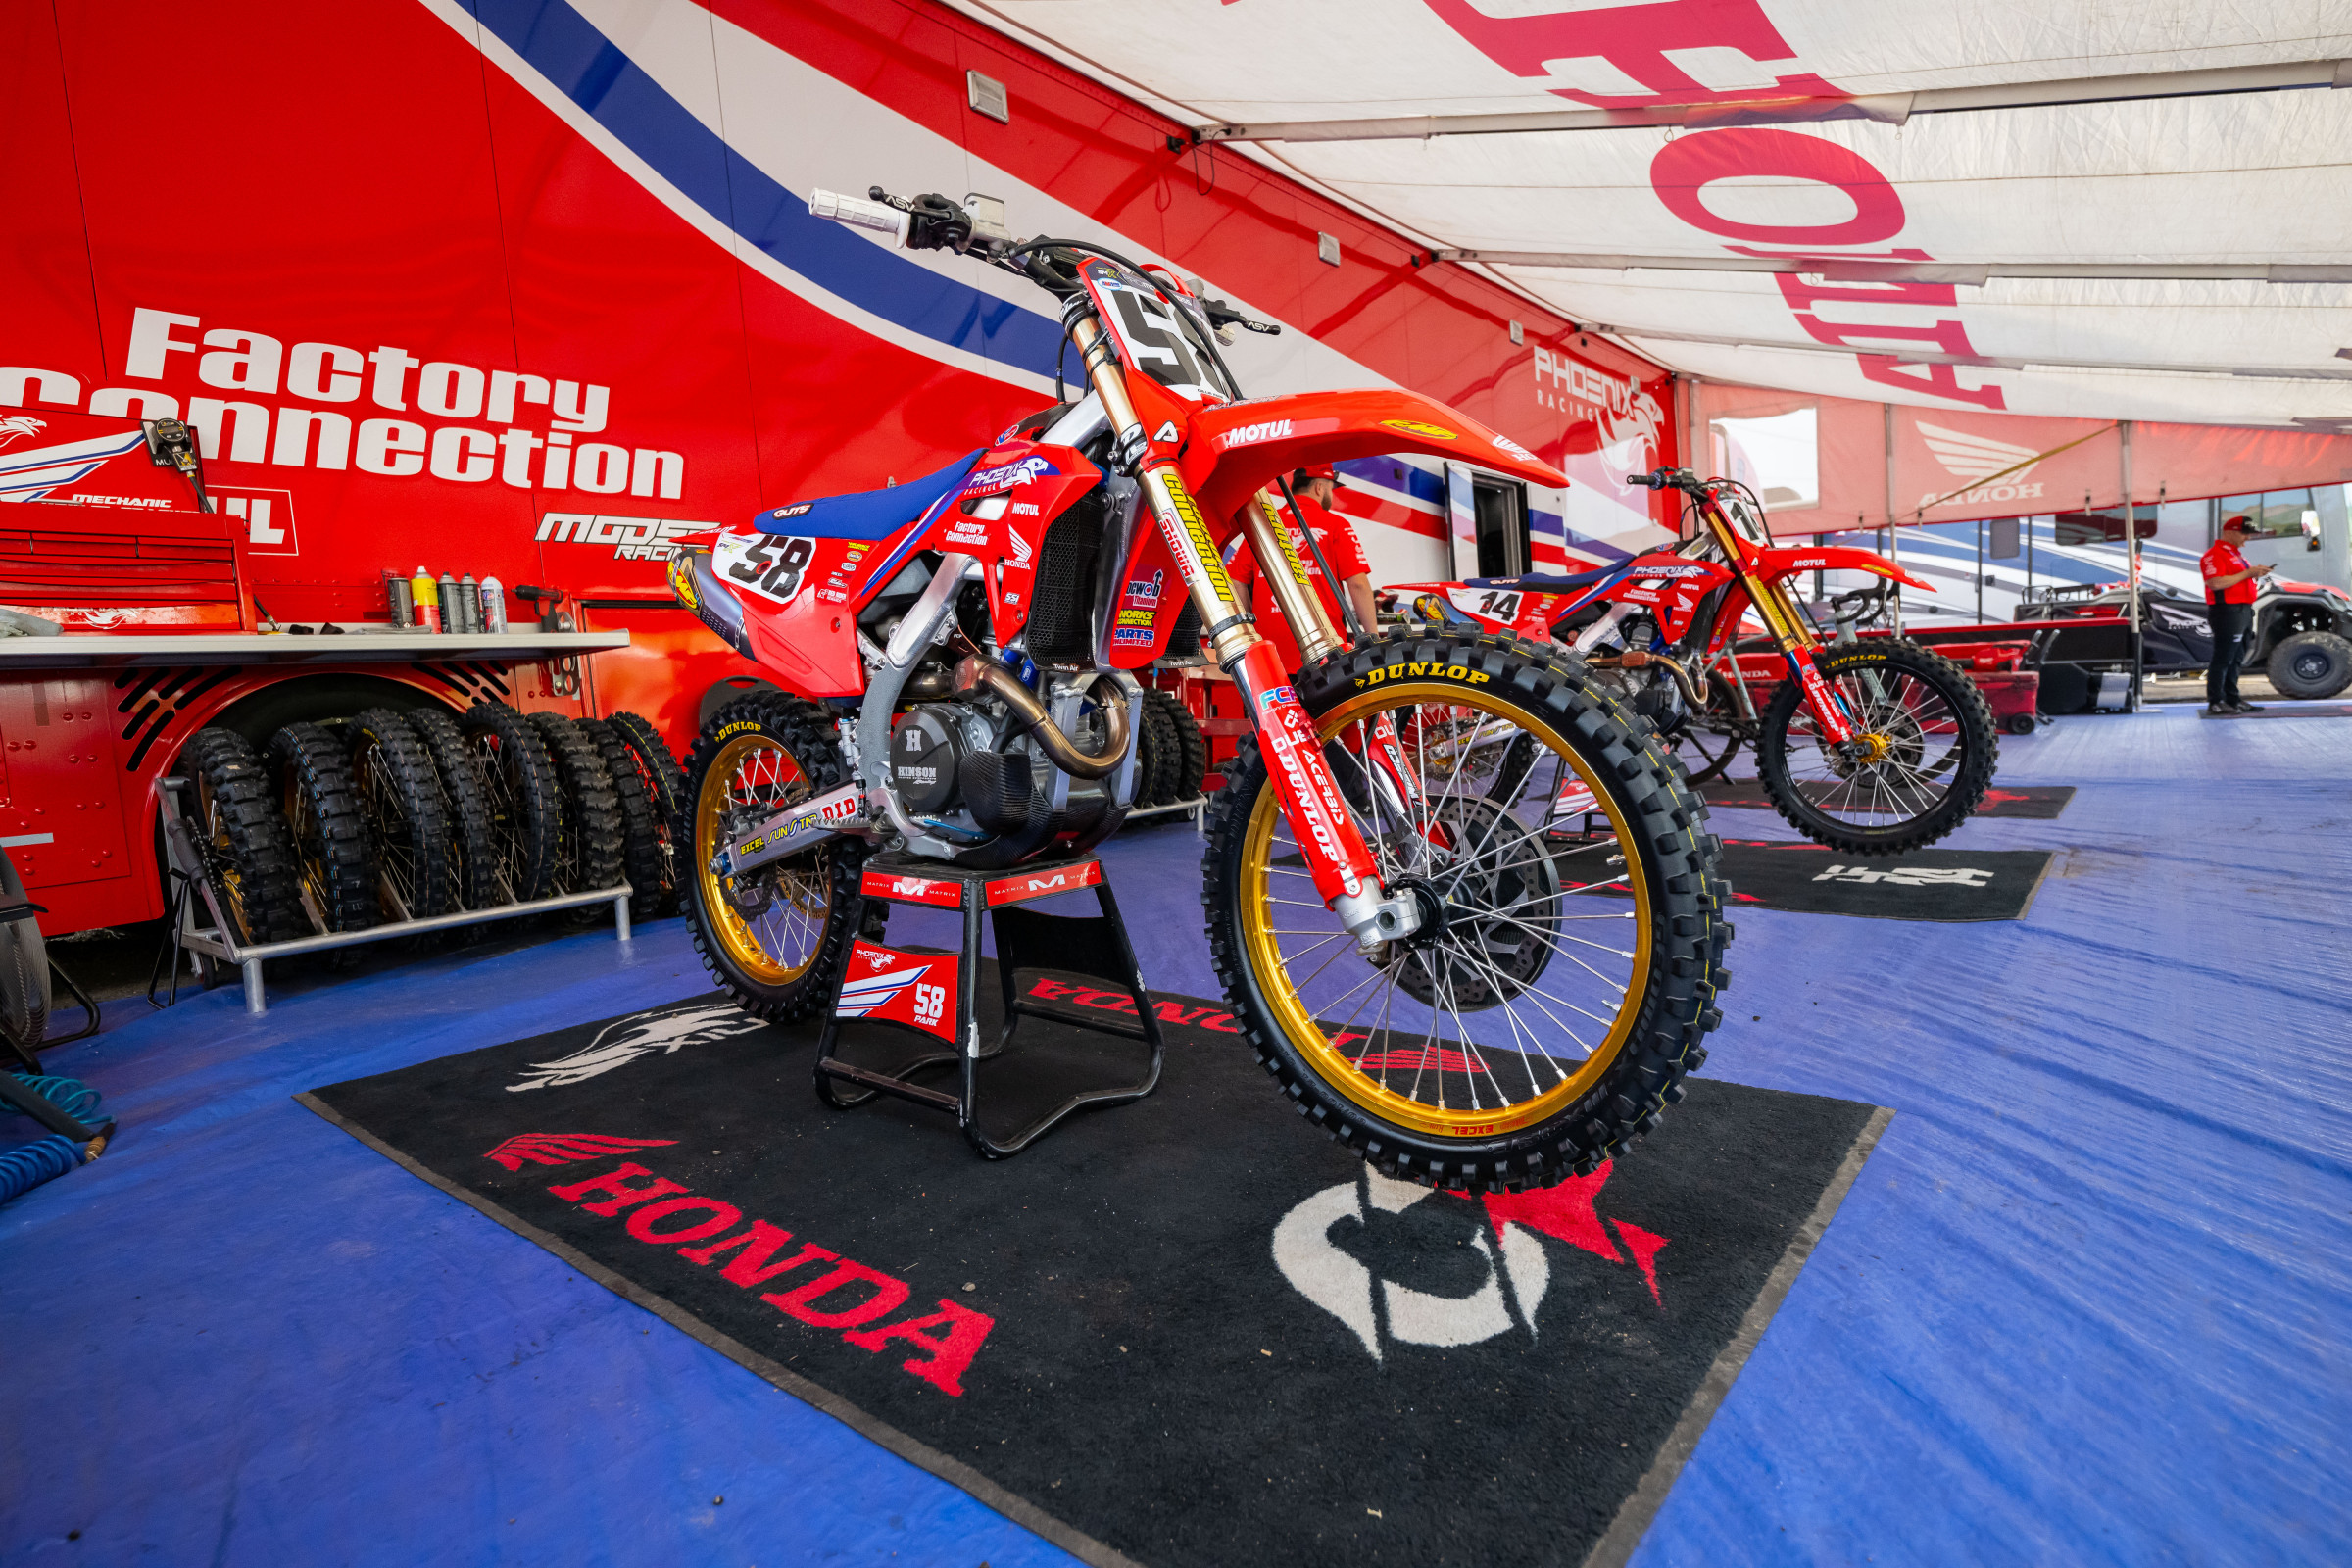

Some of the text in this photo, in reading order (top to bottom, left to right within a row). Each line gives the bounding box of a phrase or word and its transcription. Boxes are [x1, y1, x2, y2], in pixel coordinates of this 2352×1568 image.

[885, 196, 916, 212] ASV
[1247, 321, 1270, 332] ASV
[125, 307, 610, 433] Factory
[1534, 345, 1637, 422] PHOENIX
[1537, 389, 1594, 422] RACING
[1228, 419, 1293, 446] MOTUL
[969, 461, 1023, 487] PHOENIX
[73, 494, 172, 509] MECHANIC
[1012, 503, 1039, 515] MOTUL
[773, 503, 812, 519] GUTS
[955, 521, 986, 534] Factory
[946, 531, 989, 546] Connection
[1162, 474, 1235, 602] Connection
[1158, 517, 1195, 578] SHOWA
[729, 535, 812, 598] 58
[1004, 559, 1031, 570] HONDA
[1793, 558, 1827, 567] MOTUL
[1634, 566, 1684, 575] PHOENIX
[1118, 609, 1156, 619] WORKS
[1478, 591, 1520, 622] 14
[1054, 662, 1069, 671] Twin
[1831, 654, 1887, 667] DUNLOP
[1367, 662, 1491, 686] DUNLOP
[1722, 669, 1772, 679] HNDA
[1812, 689, 1839, 732] DUNLOP
[718, 721, 761, 741] DUNLOP
[898, 766, 937, 778] HINSON
[1277, 753, 1339, 862] DUNLOP
[740, 836, 765, 856] EXCEL
[929, 889, 956, 898] MATRIX
[994, 885, 1025, 895] MATRIX
[856, 949, 885, 958] PHOENIX
[913, 983, 946, 1019] 58
[913, 1015, 939, 1027] PARK
[1452, 1124, 1494, 1135] EXCEL
[547, 1161, 996, 1396] HONDA
